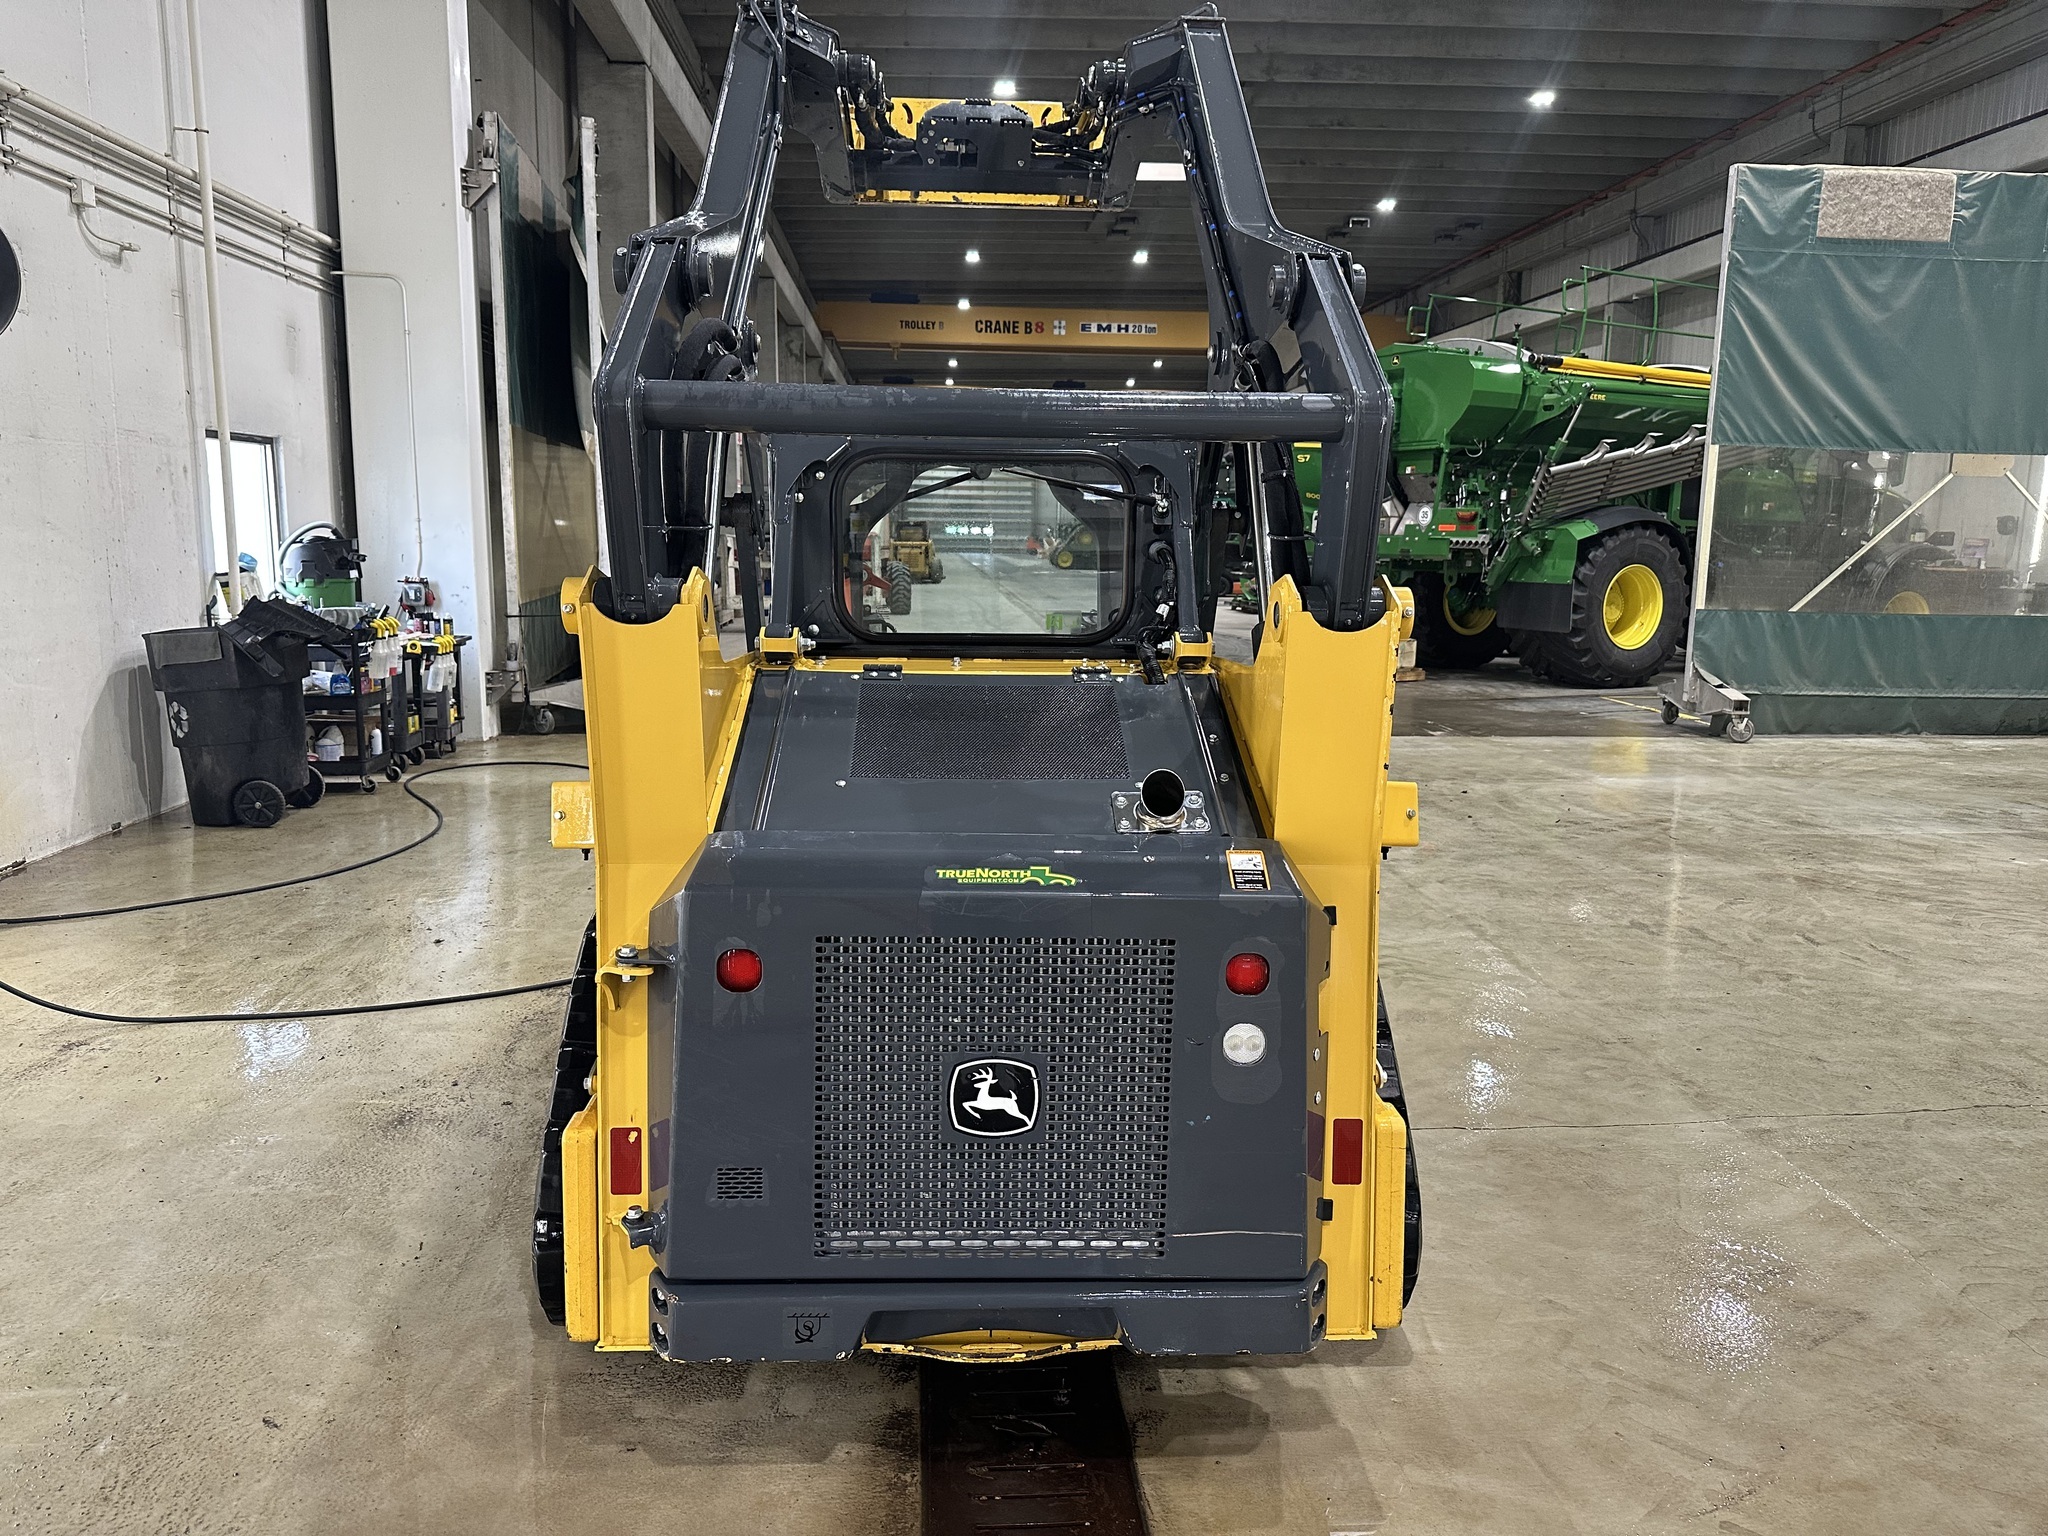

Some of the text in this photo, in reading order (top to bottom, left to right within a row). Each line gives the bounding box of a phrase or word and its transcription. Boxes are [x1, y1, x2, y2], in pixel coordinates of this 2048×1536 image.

[899, 319, 936, 330] TROLLEY
[975, 319, 1045, 334] CRANE B8
[1131, 324, 1143, 334] 20
[1144, 324, 1157, 334] ton
[1590, 393, 1607, 401] EERE
[1420, 510, 1429, 519] 35
[935, 867, 1032, 878] TRUENORTH
